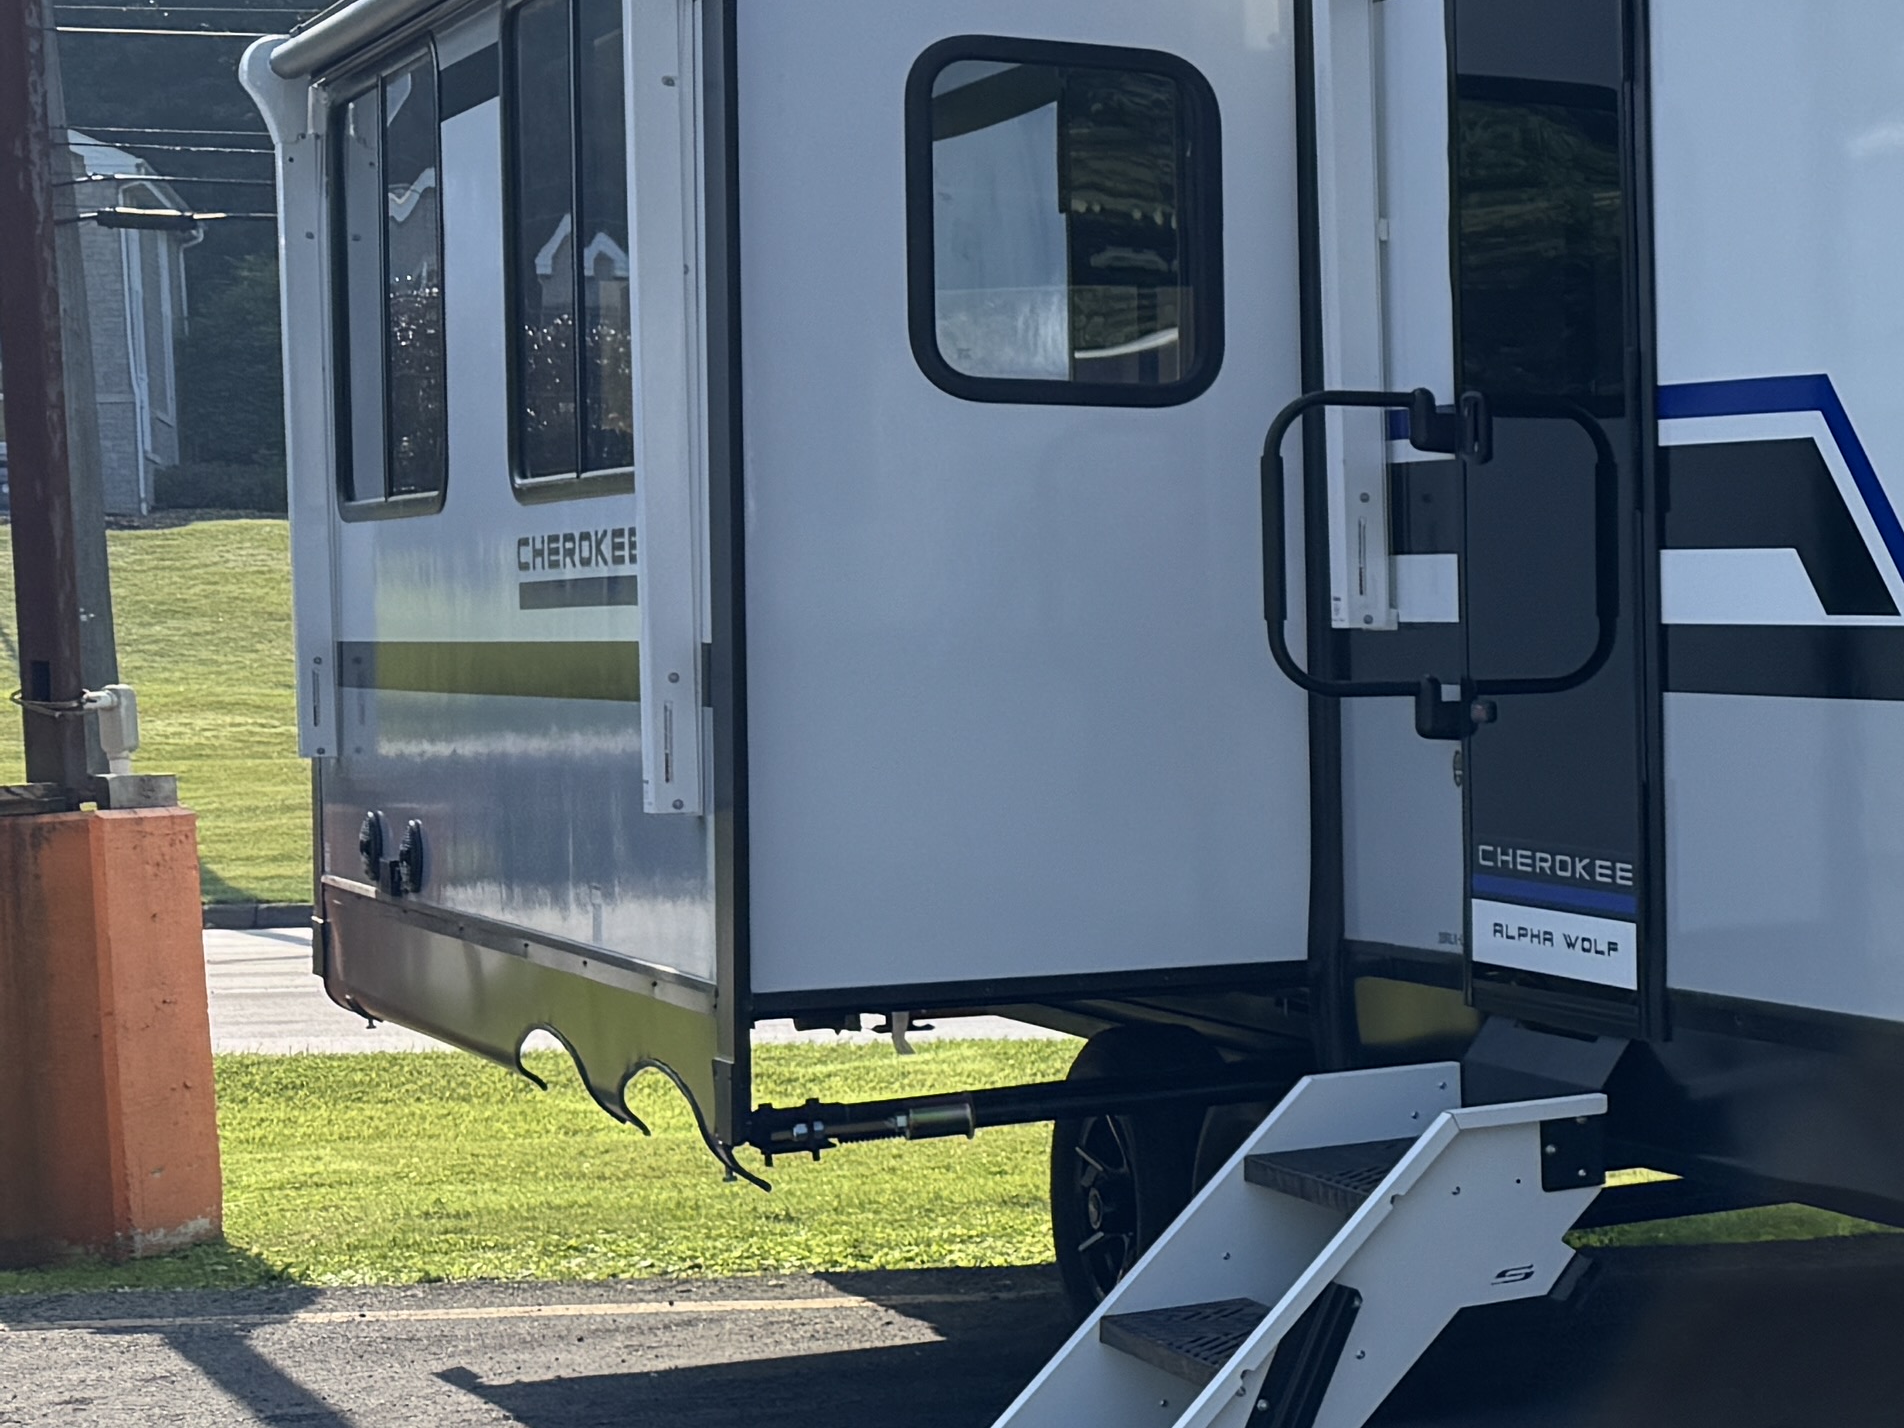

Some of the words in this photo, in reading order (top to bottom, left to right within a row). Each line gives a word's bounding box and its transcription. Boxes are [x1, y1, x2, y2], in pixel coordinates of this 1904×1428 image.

[1478, 844, 1634, 886] CHEROKEE
[1493, 922, 1555, 947] ALPHA
[1563, 933, 1619, 957] WOLF
